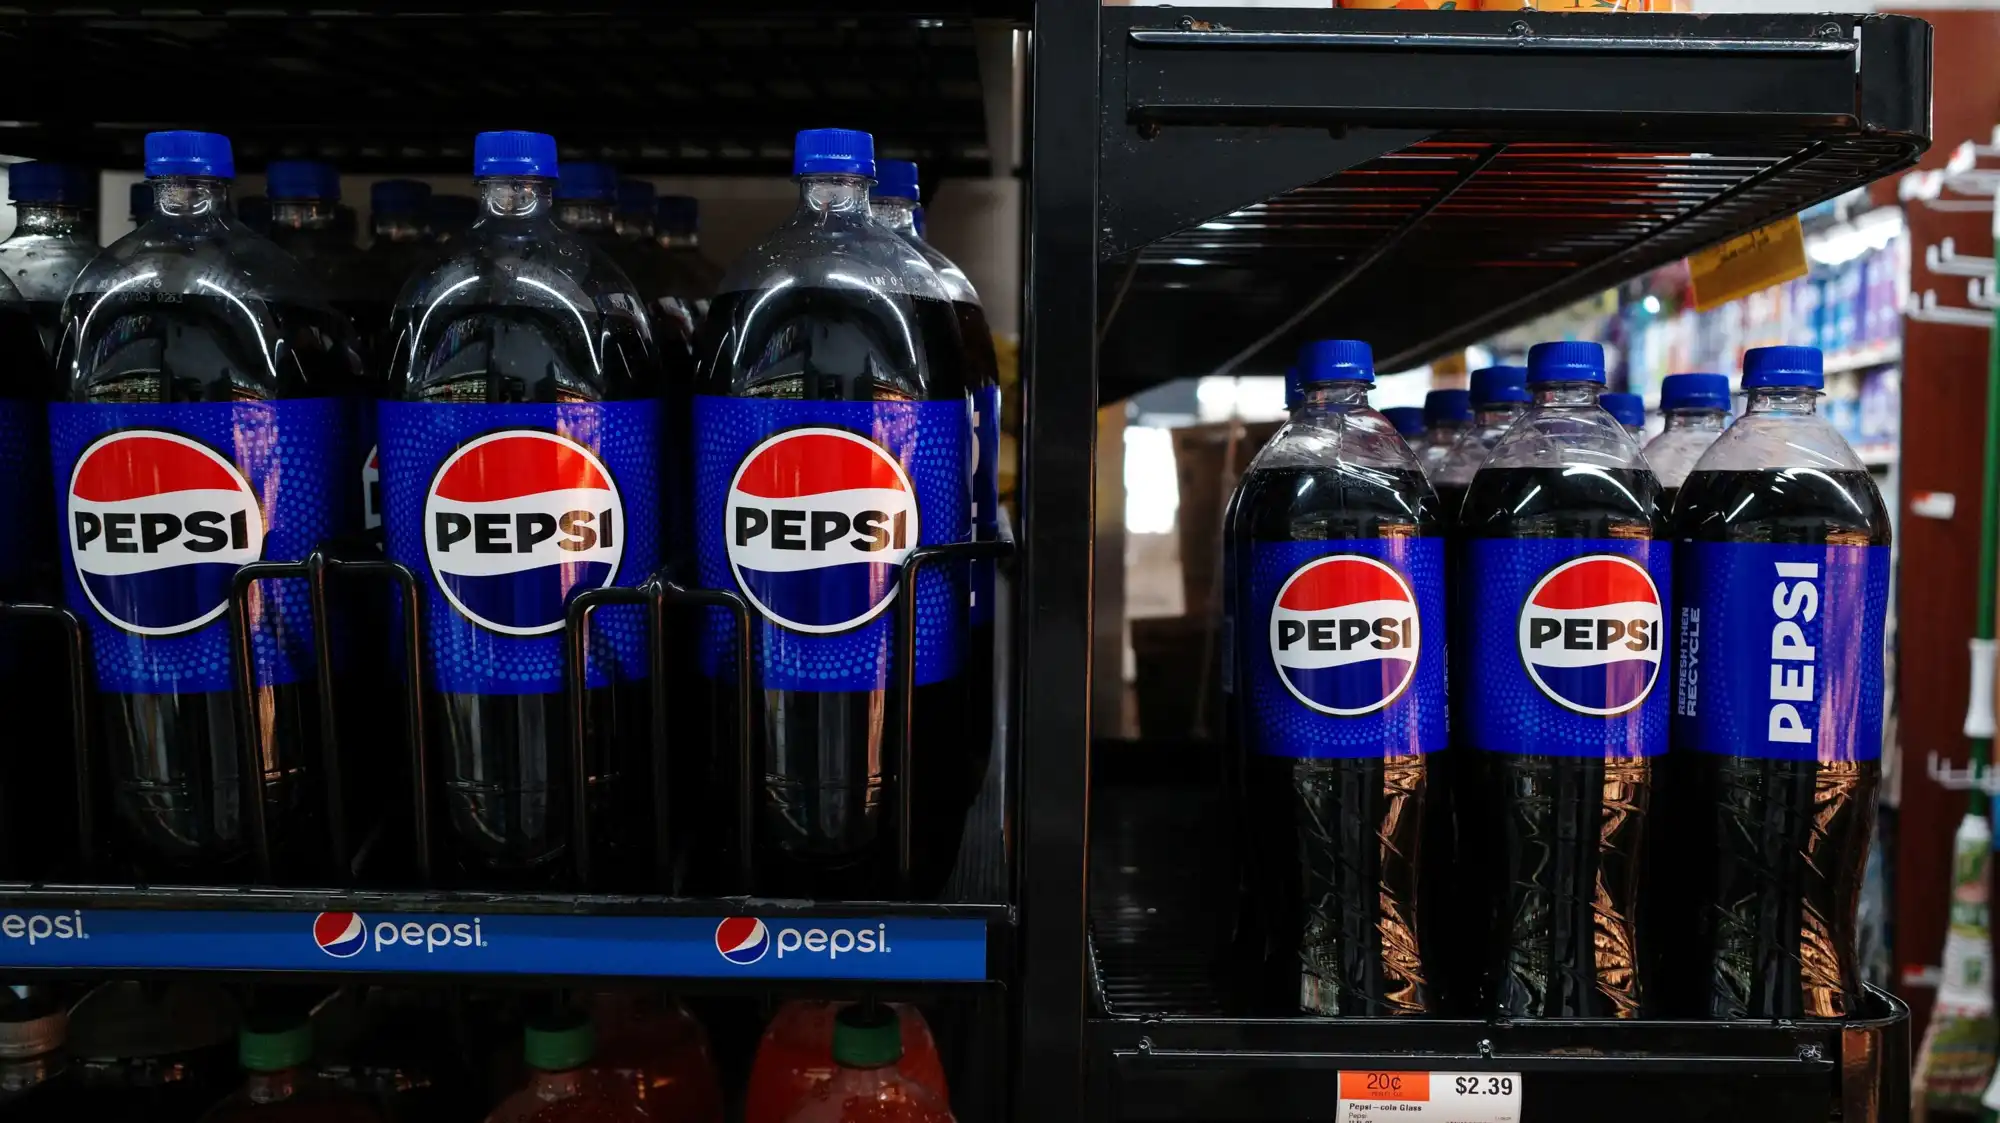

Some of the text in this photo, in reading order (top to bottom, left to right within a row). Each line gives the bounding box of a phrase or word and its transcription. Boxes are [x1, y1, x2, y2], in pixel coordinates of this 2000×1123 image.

[75, 509, 248, 554] PEPSI
[436, 508, 613, 554] PEPSI
[736, 507, 907, 552] PEPSI
[1278, 617, 1412, 652] PEPSI
[1530, 618, 1658, 652] PEPSI
[1769, 562, 1819, 744] PEPSI
[1677, 607, 1691, 717] REFRESH THEN
[1687, 607, 1701, 718] RECYCLE
[2, 909, 84, 946] epsi
[374, 916, 483, 954] pepsi
[777, 922, 886, 960] pepsi
[1367, 1073, 1513, 1096] 20¢ $2.39
[1348, 1112, 1367, 1120] Pepsi
[1399, 1104, 1423, 1112] Glass
